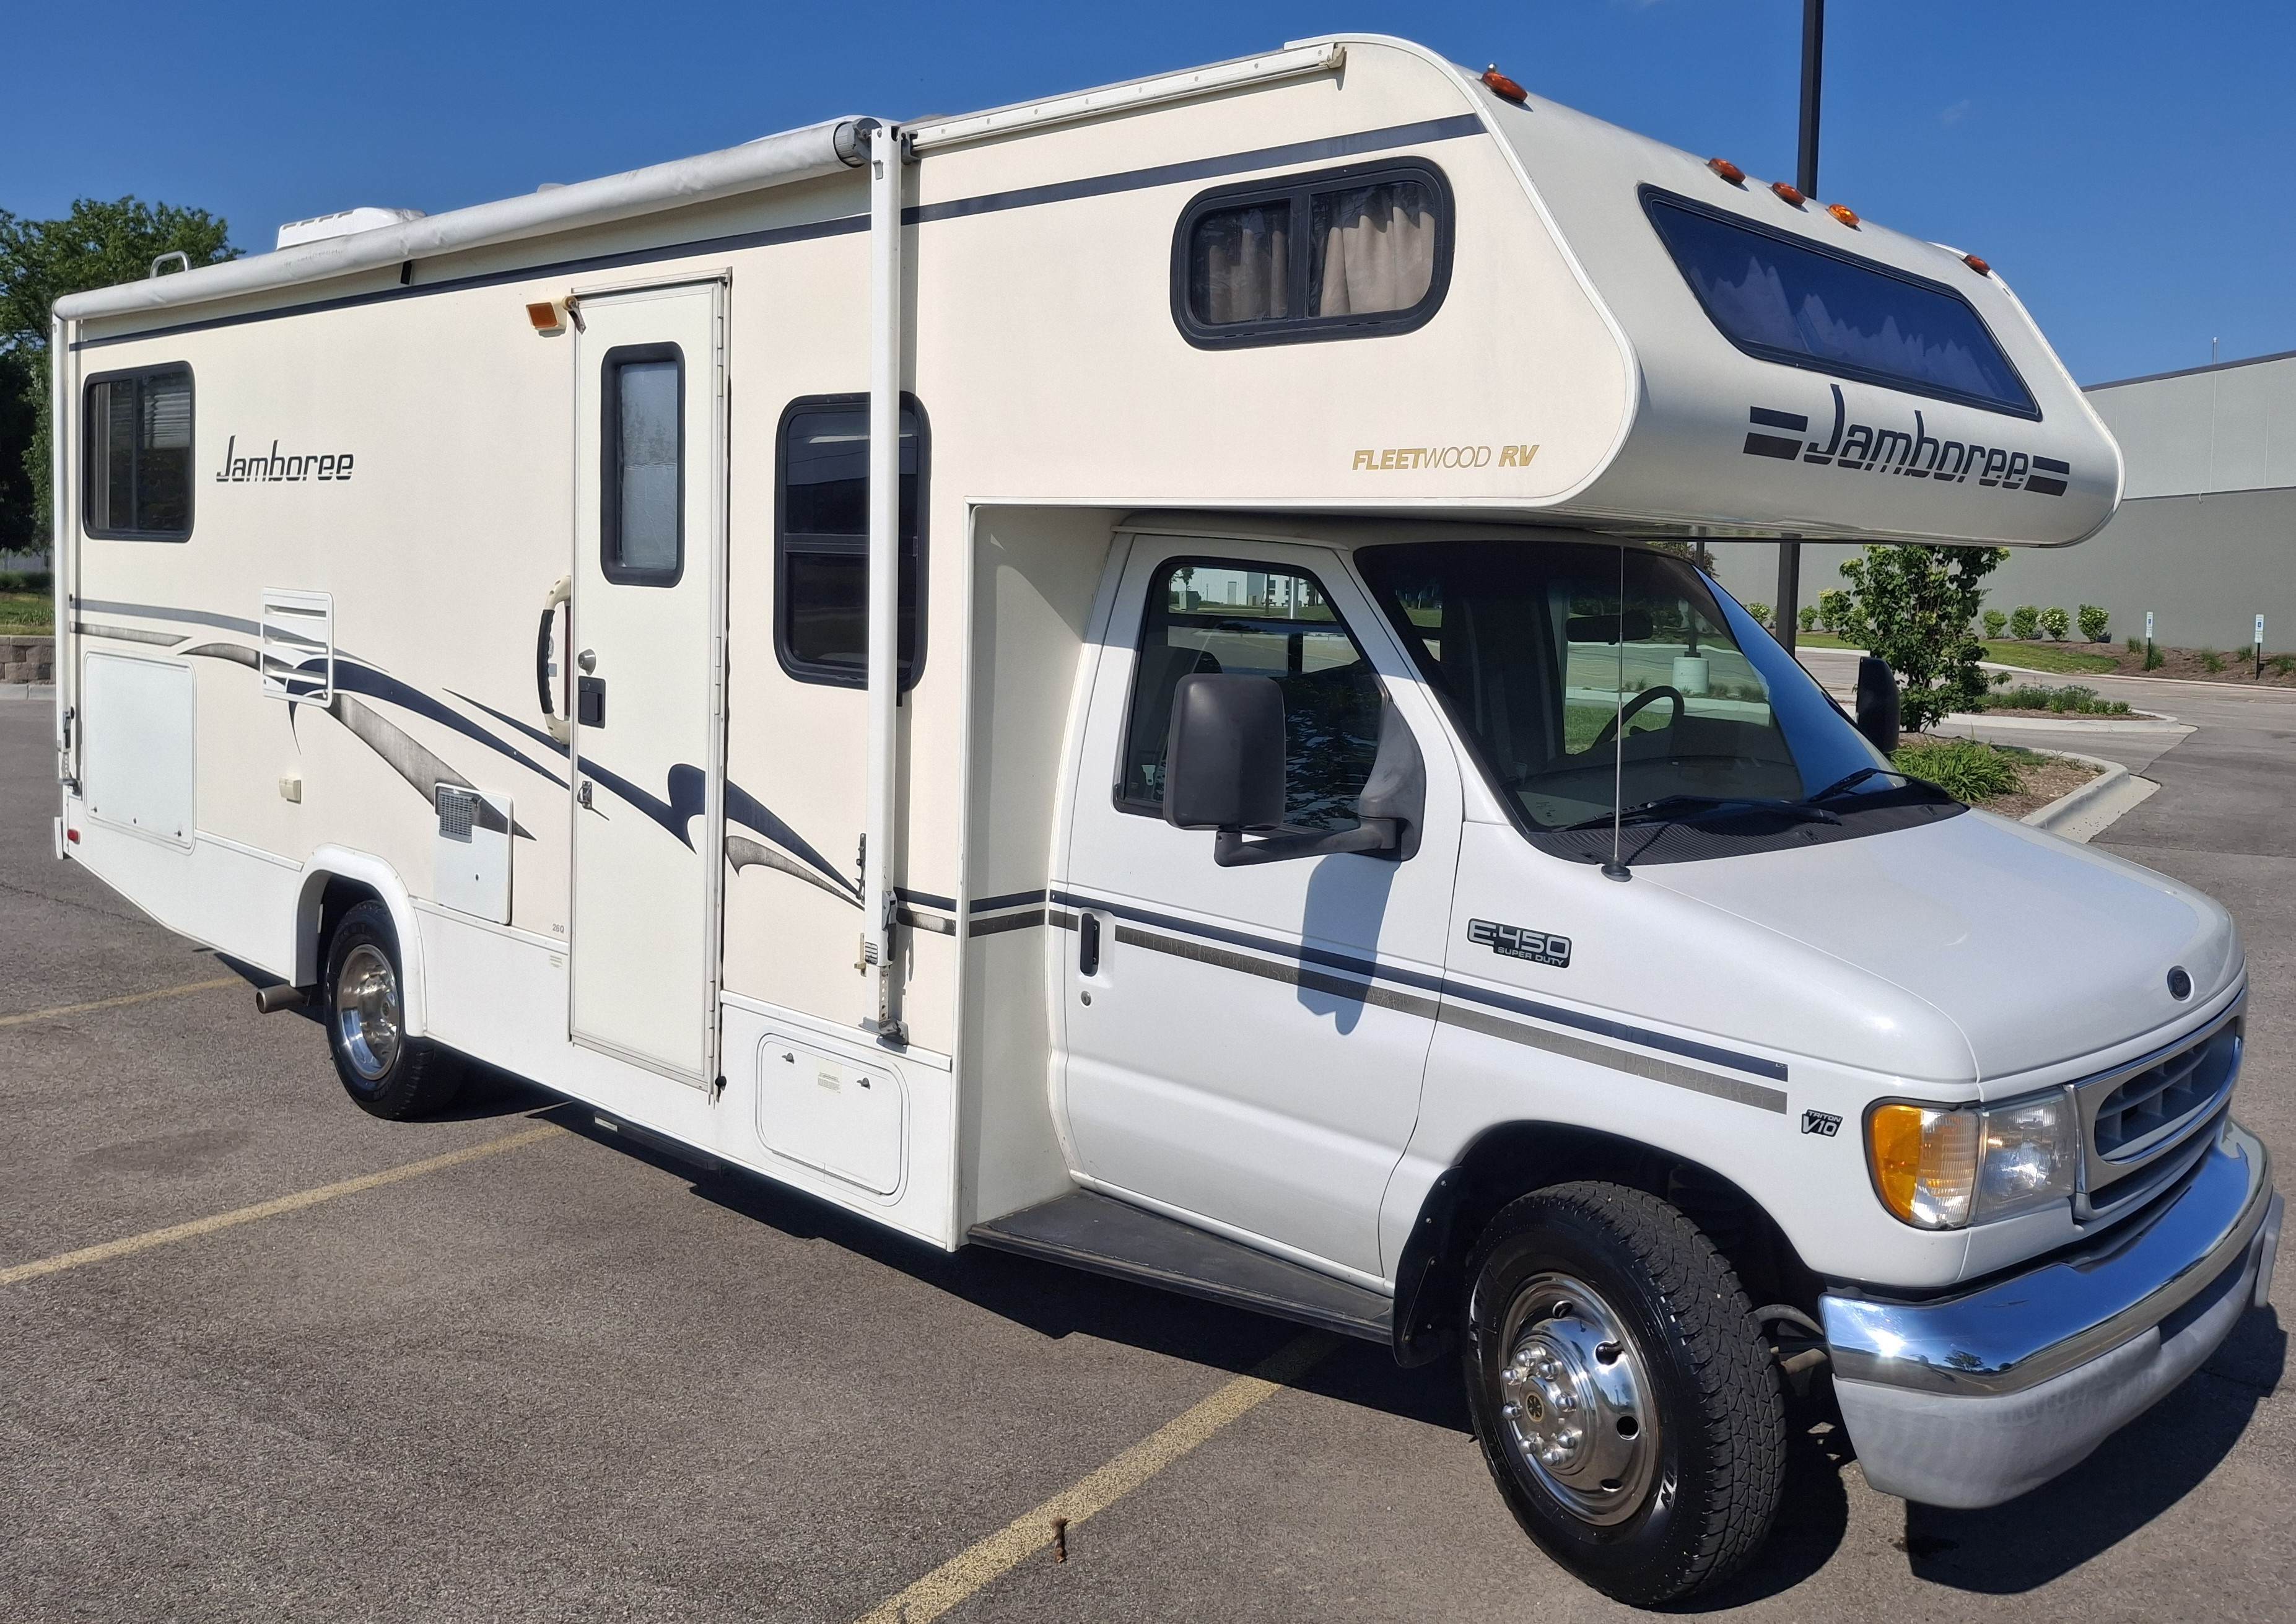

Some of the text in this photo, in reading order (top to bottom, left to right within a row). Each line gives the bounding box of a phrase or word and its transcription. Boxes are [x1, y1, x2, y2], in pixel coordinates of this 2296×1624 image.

[1803, 383, 2029, 489] Jamboree
[216, 435, 354, 482] Jamboree
[1352, 444, 1540, 470] FLEETWOOD RV
[1497, 946, 1565, 966] SUPER DUTY
[1802, 1115, 1838, 1135] V10
[1808, 1111, 1841, 1122] TRITON
